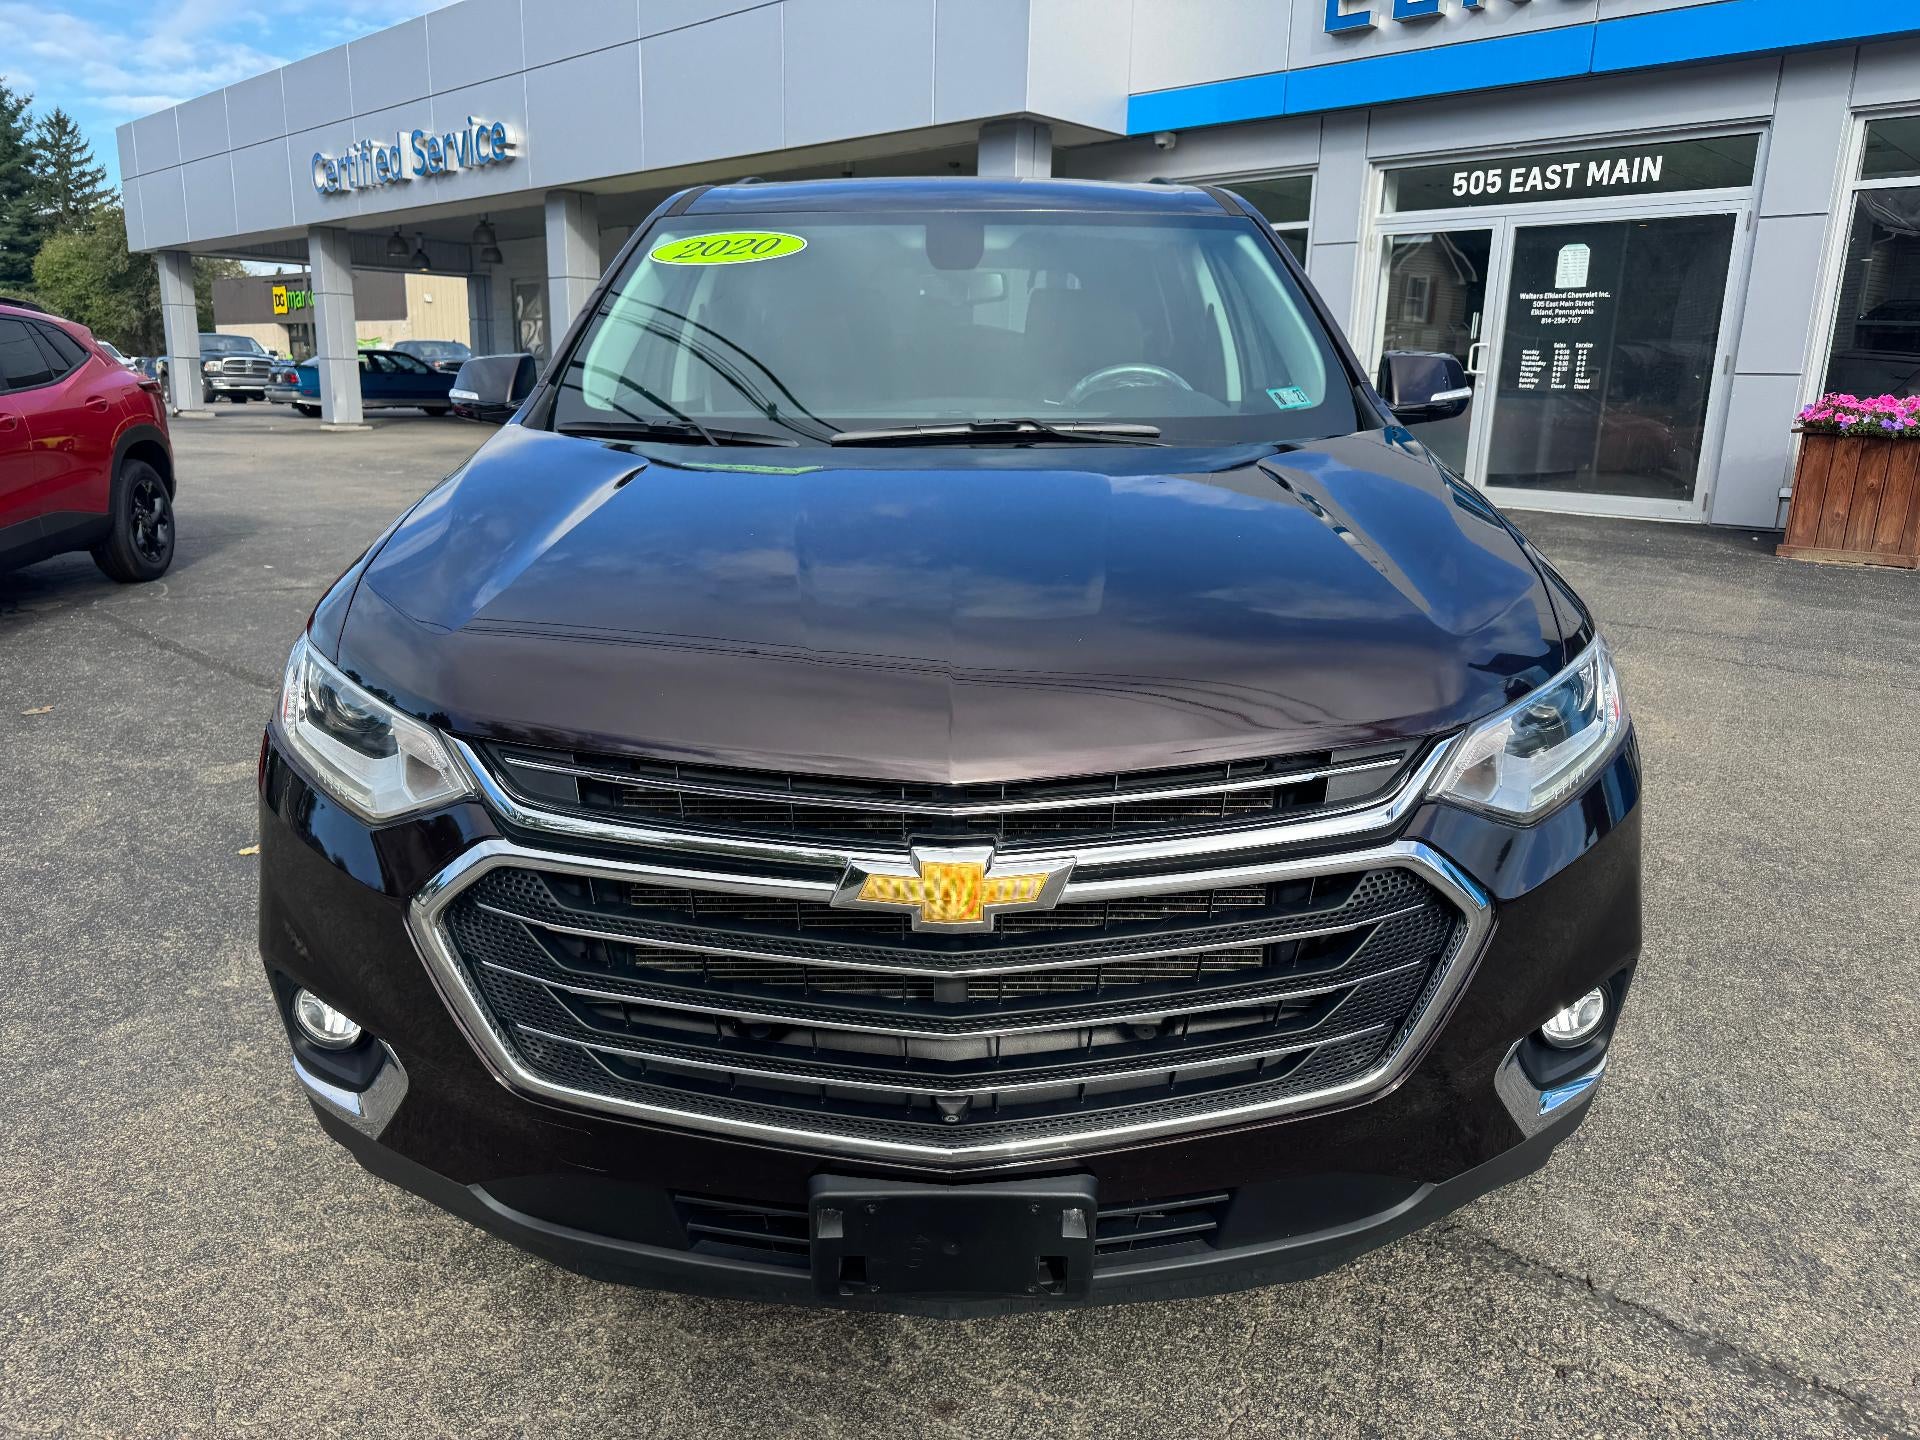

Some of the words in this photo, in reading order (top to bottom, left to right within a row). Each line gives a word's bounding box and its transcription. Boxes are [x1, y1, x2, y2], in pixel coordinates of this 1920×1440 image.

[312, 131, 404, 194] Certified
[410, 115, 507, 177] Service
[1452, 168, 1502, 197] 505
[1508, 162, 1581, 193] EAST
[1586, 155, 1663, 187] MAIN
[672, 237, 782, 260] 2020
[1520, 292, 1543, 300] Walters
[1567, 291, 1598, 299] Chevrolet
[1554, 308, 1594, 316] Pennsylvania
